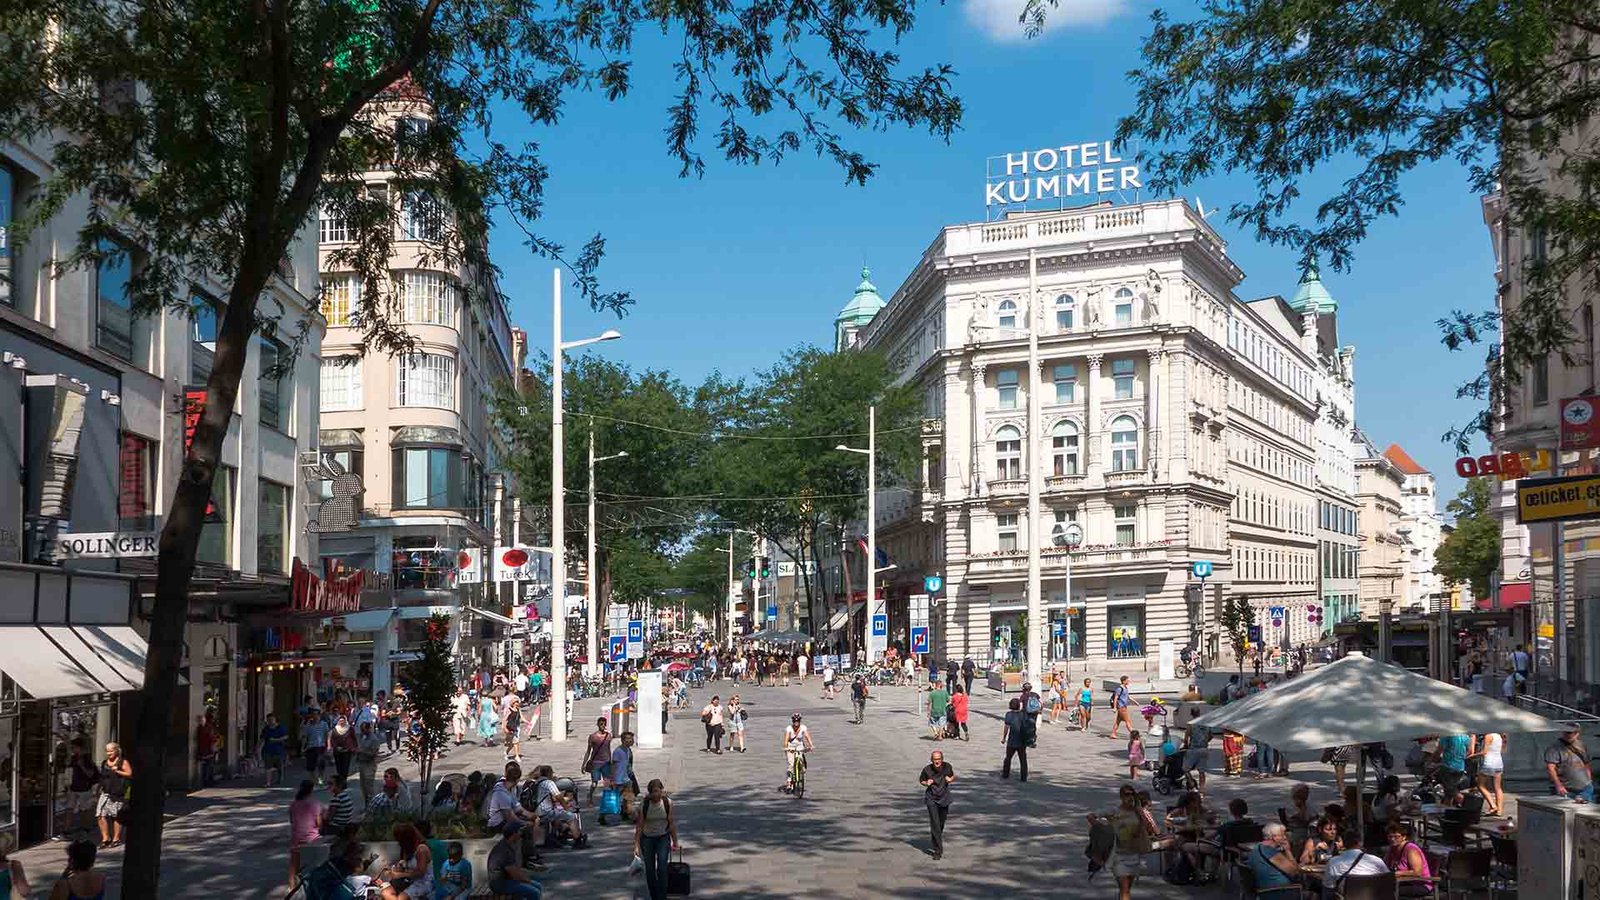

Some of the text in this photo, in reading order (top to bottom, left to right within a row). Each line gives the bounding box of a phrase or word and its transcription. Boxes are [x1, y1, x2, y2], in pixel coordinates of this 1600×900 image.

[1006, 141, 1121, 175] HOTEL
[986, 166, 1142, 205] KUMMER
[61, 536, 155, 554] SOLINGER
[1196, 564, 1207, 576] U
[929, 579, 940, 591] U
